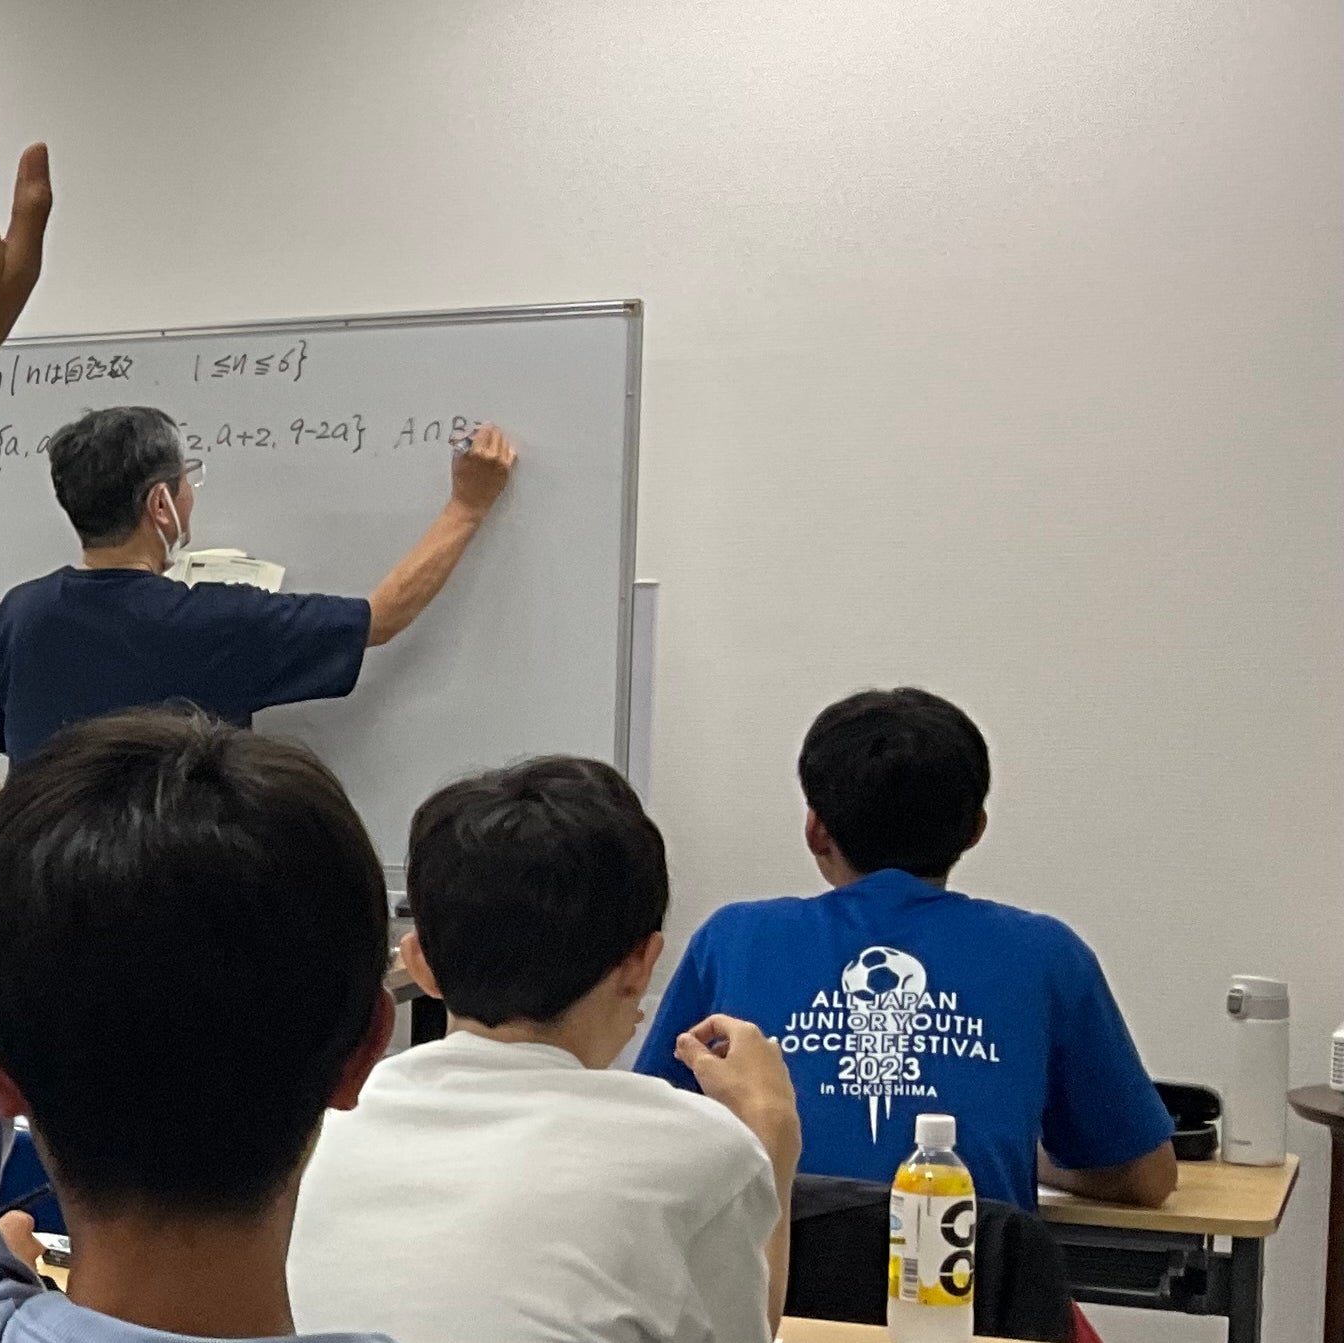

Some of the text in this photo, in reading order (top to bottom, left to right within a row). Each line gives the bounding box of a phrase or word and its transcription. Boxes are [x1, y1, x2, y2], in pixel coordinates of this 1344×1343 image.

[812, 990, 957, 1011] ALL JAPAN
[785, 1011, 983, 1037] JUNIOR YOUTH
[767, 1033, 1000, 1063] OCCER FESTIVAL
[837, 1056, 921, 1081] 2023
[842, 1083, 938, 1098] TOKUSHIMA
